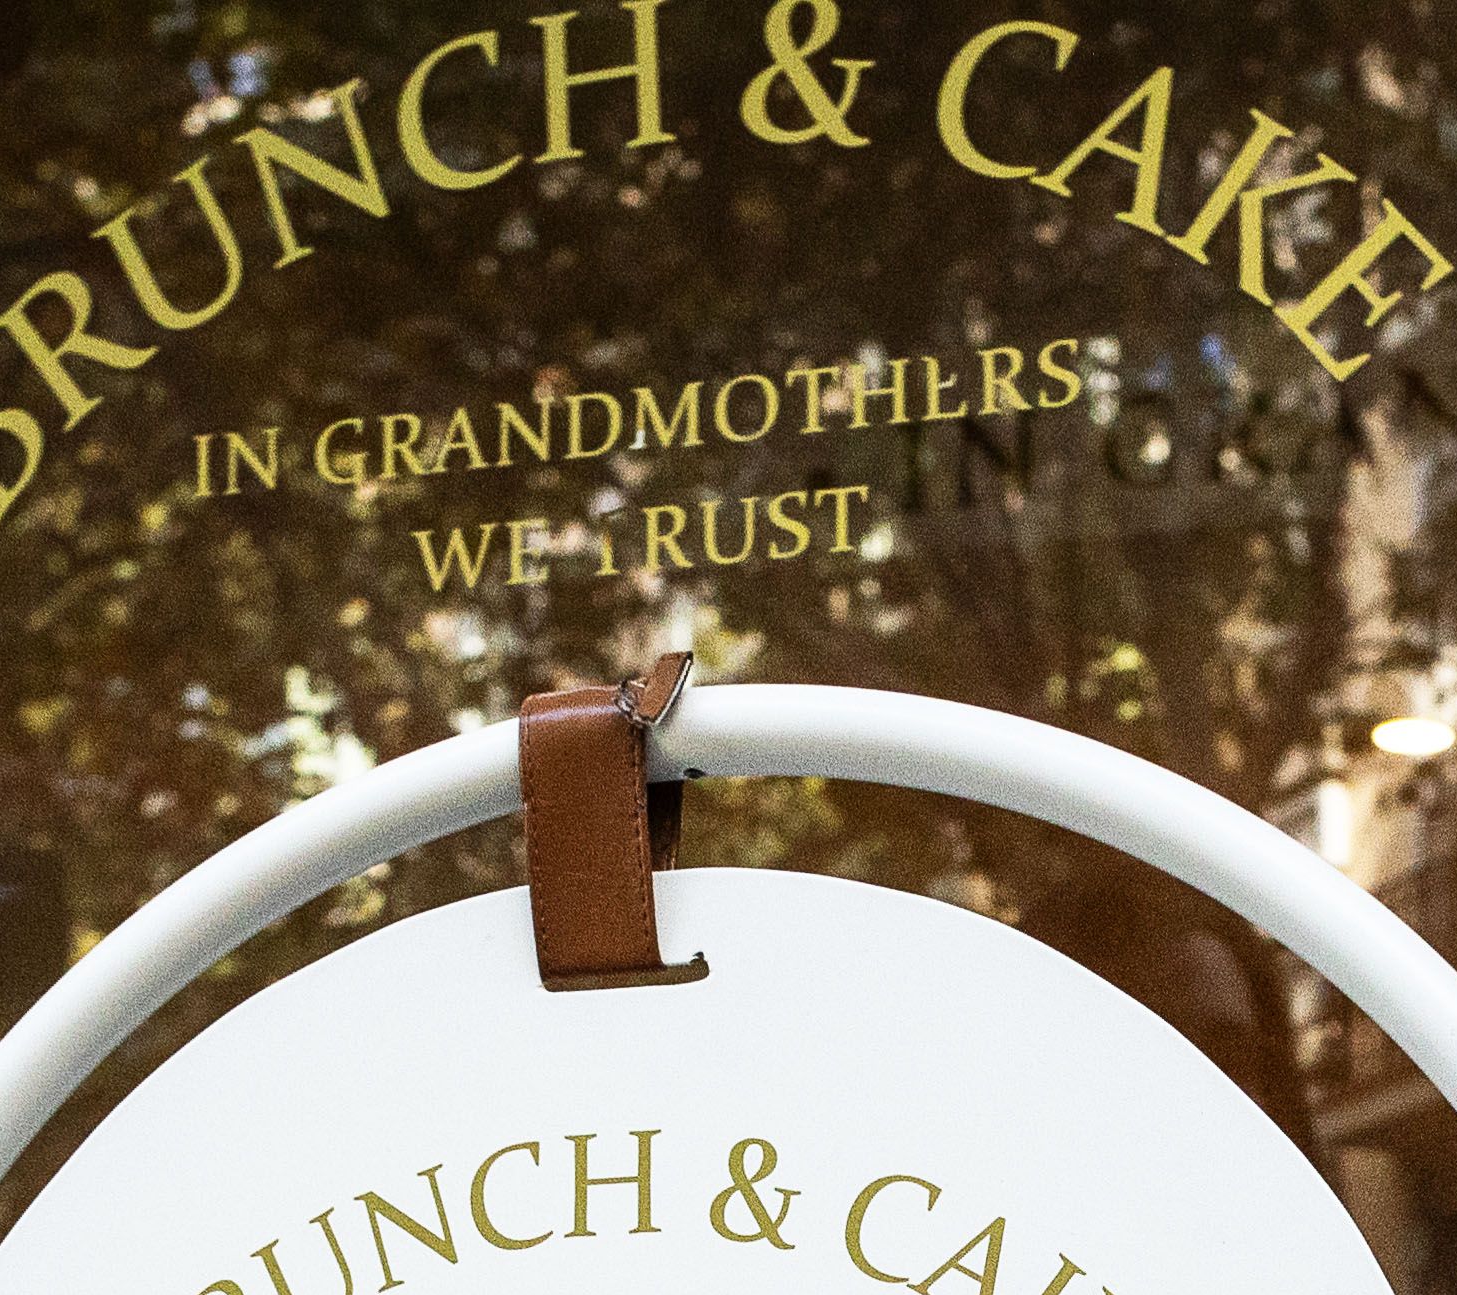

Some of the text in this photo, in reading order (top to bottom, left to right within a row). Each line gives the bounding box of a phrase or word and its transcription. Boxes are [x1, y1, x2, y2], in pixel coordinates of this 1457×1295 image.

[741, 0, 876, 149] &
[936, 19, 1454, 382] CAKE
[193, 432, 279, 498] IN
[313, 338, 1083, 486] GRANDMOTHERS
[411, 519, 550, 593] WE
[709, 1138, 801, 1250] &
